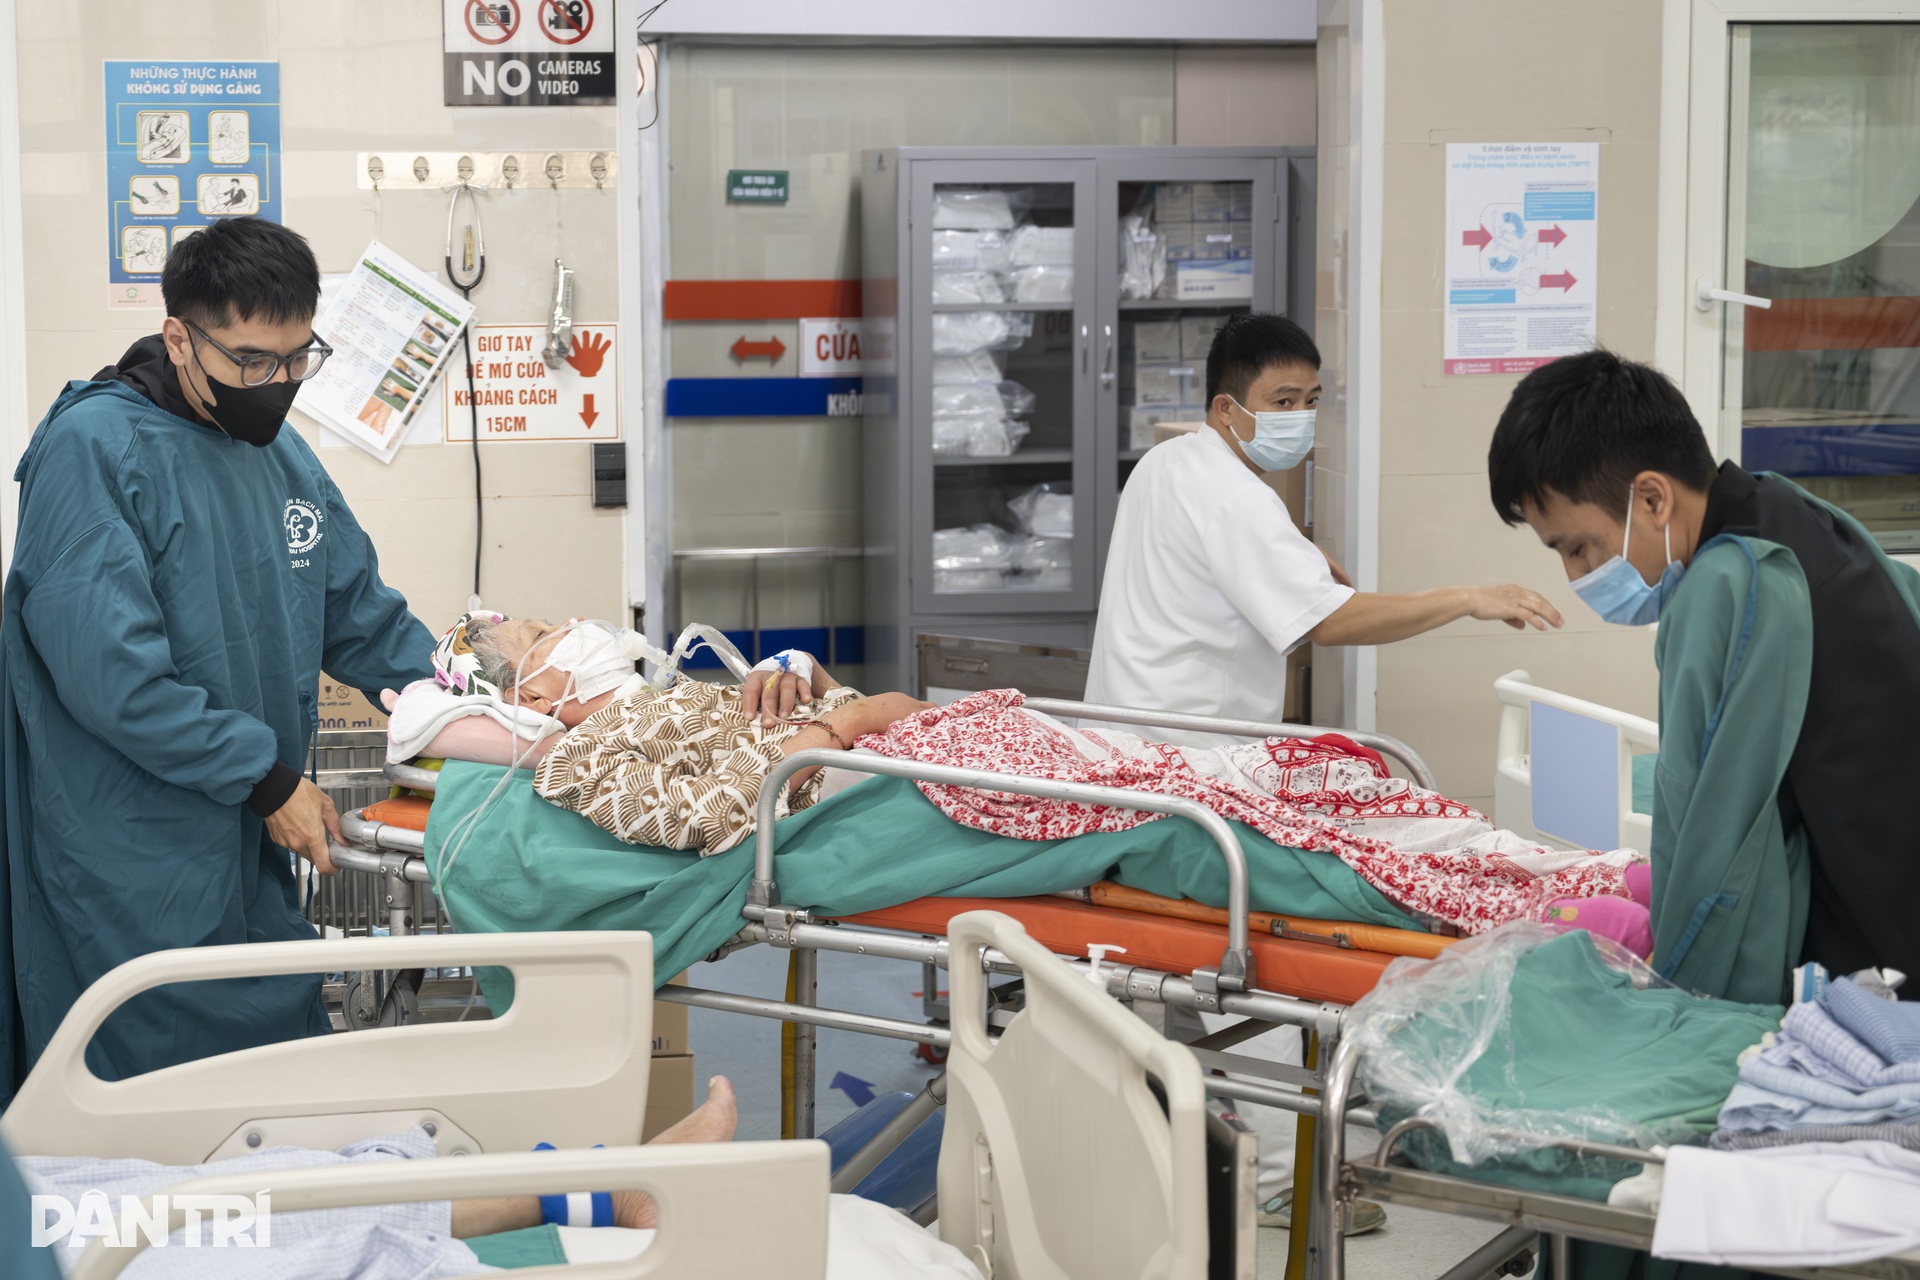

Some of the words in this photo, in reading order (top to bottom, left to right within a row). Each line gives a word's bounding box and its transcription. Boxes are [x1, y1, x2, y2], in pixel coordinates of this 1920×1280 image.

[130, 65, 179, 79] NHỮNG
[182, 66, 217, 80] THỰC
[463, 60, 531, 96] NO
[538, 60, 602, 75] CAMERAS
[126, 80, 170, 94] KHÔNG
[173, 80, 188, 94] SỬ
[190, 83, 223, 96] DỤNG
[538, 80, 580, 95] VIDEO
[478, 334, 503, 352] GIƠ
[507, 335, 533, 351] TAY
[816, 322, 861, 361] CỬA
[489, 356, 513, 378] MỞ
[517, 356, 545, 378] CỬA
[454, 383, 514, 406] KHOẢNG
[519, 384, 557, 405] CÁCH
[827, 389, 863, 416] KHÔ
[486, 416, 527, 432] 15CM
[314, 509, 324, 523] MAI
[299, 532, 324, 554] HOSPITAL
[291, 559, 310, 569] 2024
